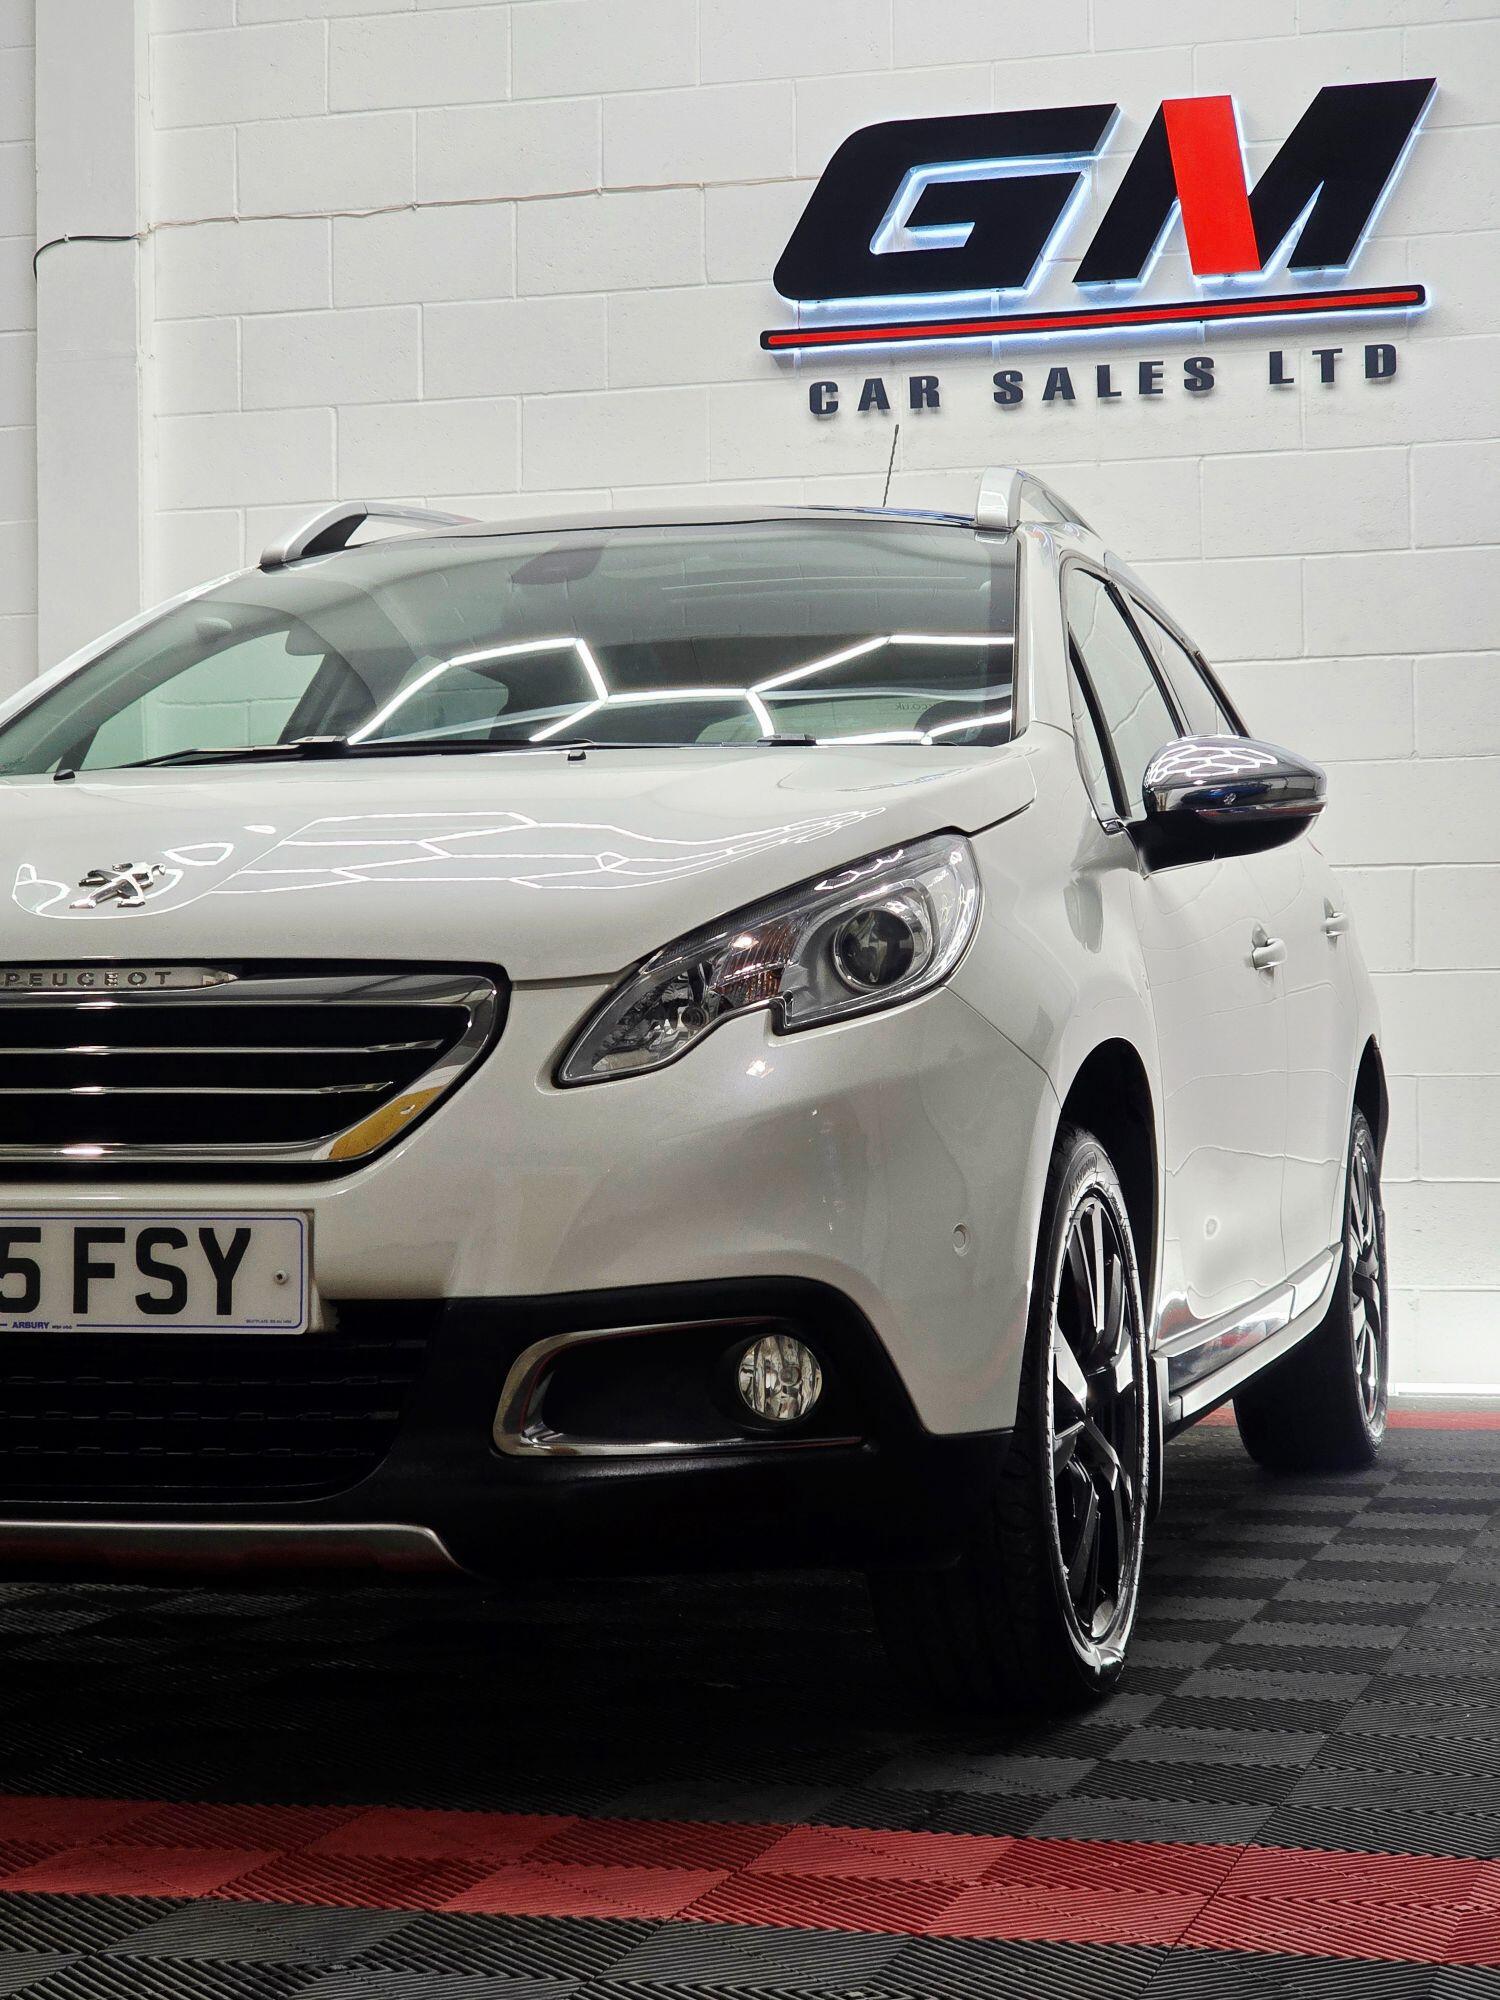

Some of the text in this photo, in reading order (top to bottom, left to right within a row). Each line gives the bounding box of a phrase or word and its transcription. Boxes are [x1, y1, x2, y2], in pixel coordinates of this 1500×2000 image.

[773, 77, 1438, 301] GM
[809, 343, 1397, 416] CAR SALES LTD
[4, 971, 172, 987] PEUGEOT
[73, 1227, 251, 1315] FSY
[12, 1321, 50, 1330] ARBURY
